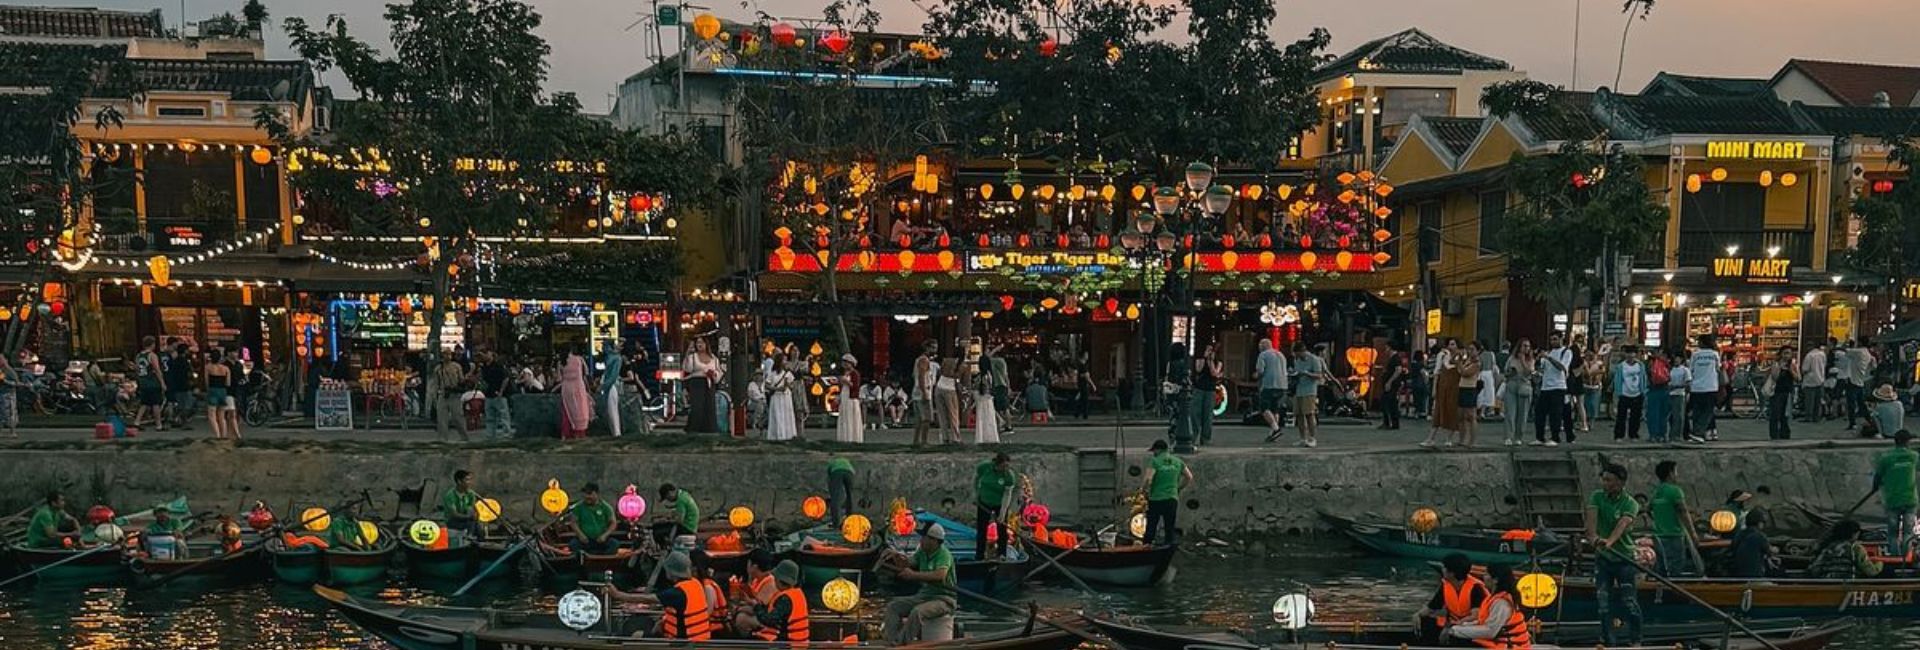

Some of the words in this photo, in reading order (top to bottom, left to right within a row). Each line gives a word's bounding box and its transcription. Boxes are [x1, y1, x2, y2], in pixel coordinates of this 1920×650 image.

[1707, 141, 1749, 158] MINI
[1753, 141, 1805, 159] MART
[1004, 252, 1047, 267] Tiger
[1051, 252, 1093, 267] Tiger
[1096, 252, 1124, 266] Bar
[1713, 258, 1744, 276] VINI
[1749, 258, 1790, 278] MART
